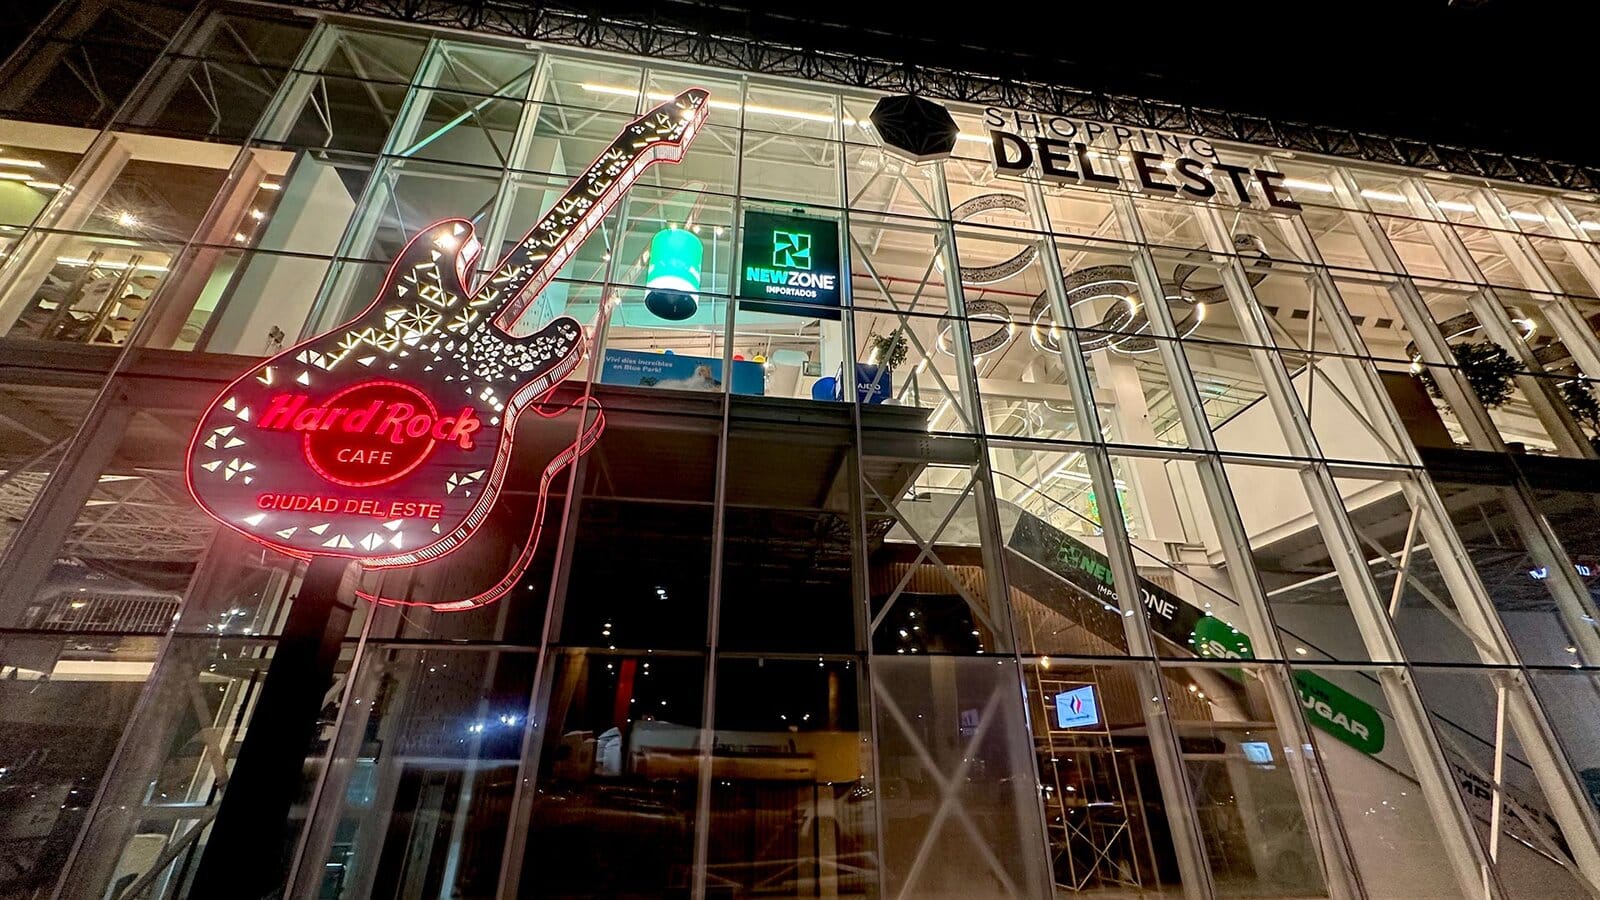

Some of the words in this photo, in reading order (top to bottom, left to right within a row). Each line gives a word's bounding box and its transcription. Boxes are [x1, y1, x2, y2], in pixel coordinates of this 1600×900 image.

[984, 107, 1216, 158] SHOPPING
[989, 130, 1120, 185] DEL
[1131, 150, 1303, 212] ESTE
[746, 266, 835, 290] NEWZONE
[766, 286, 817, 298] IMPORTADOS
[257, 394, 384, 435] Hard
[377, 403, 481, 449] Rock
[337, 447, 393, 466] CAFE
[257, 493, 340, 514] CIUDAD
[343, 496, 385, 518] DEL
[388, 501, 443, 520] ESTE
[1299, 690, 1369, 741] UGAR
